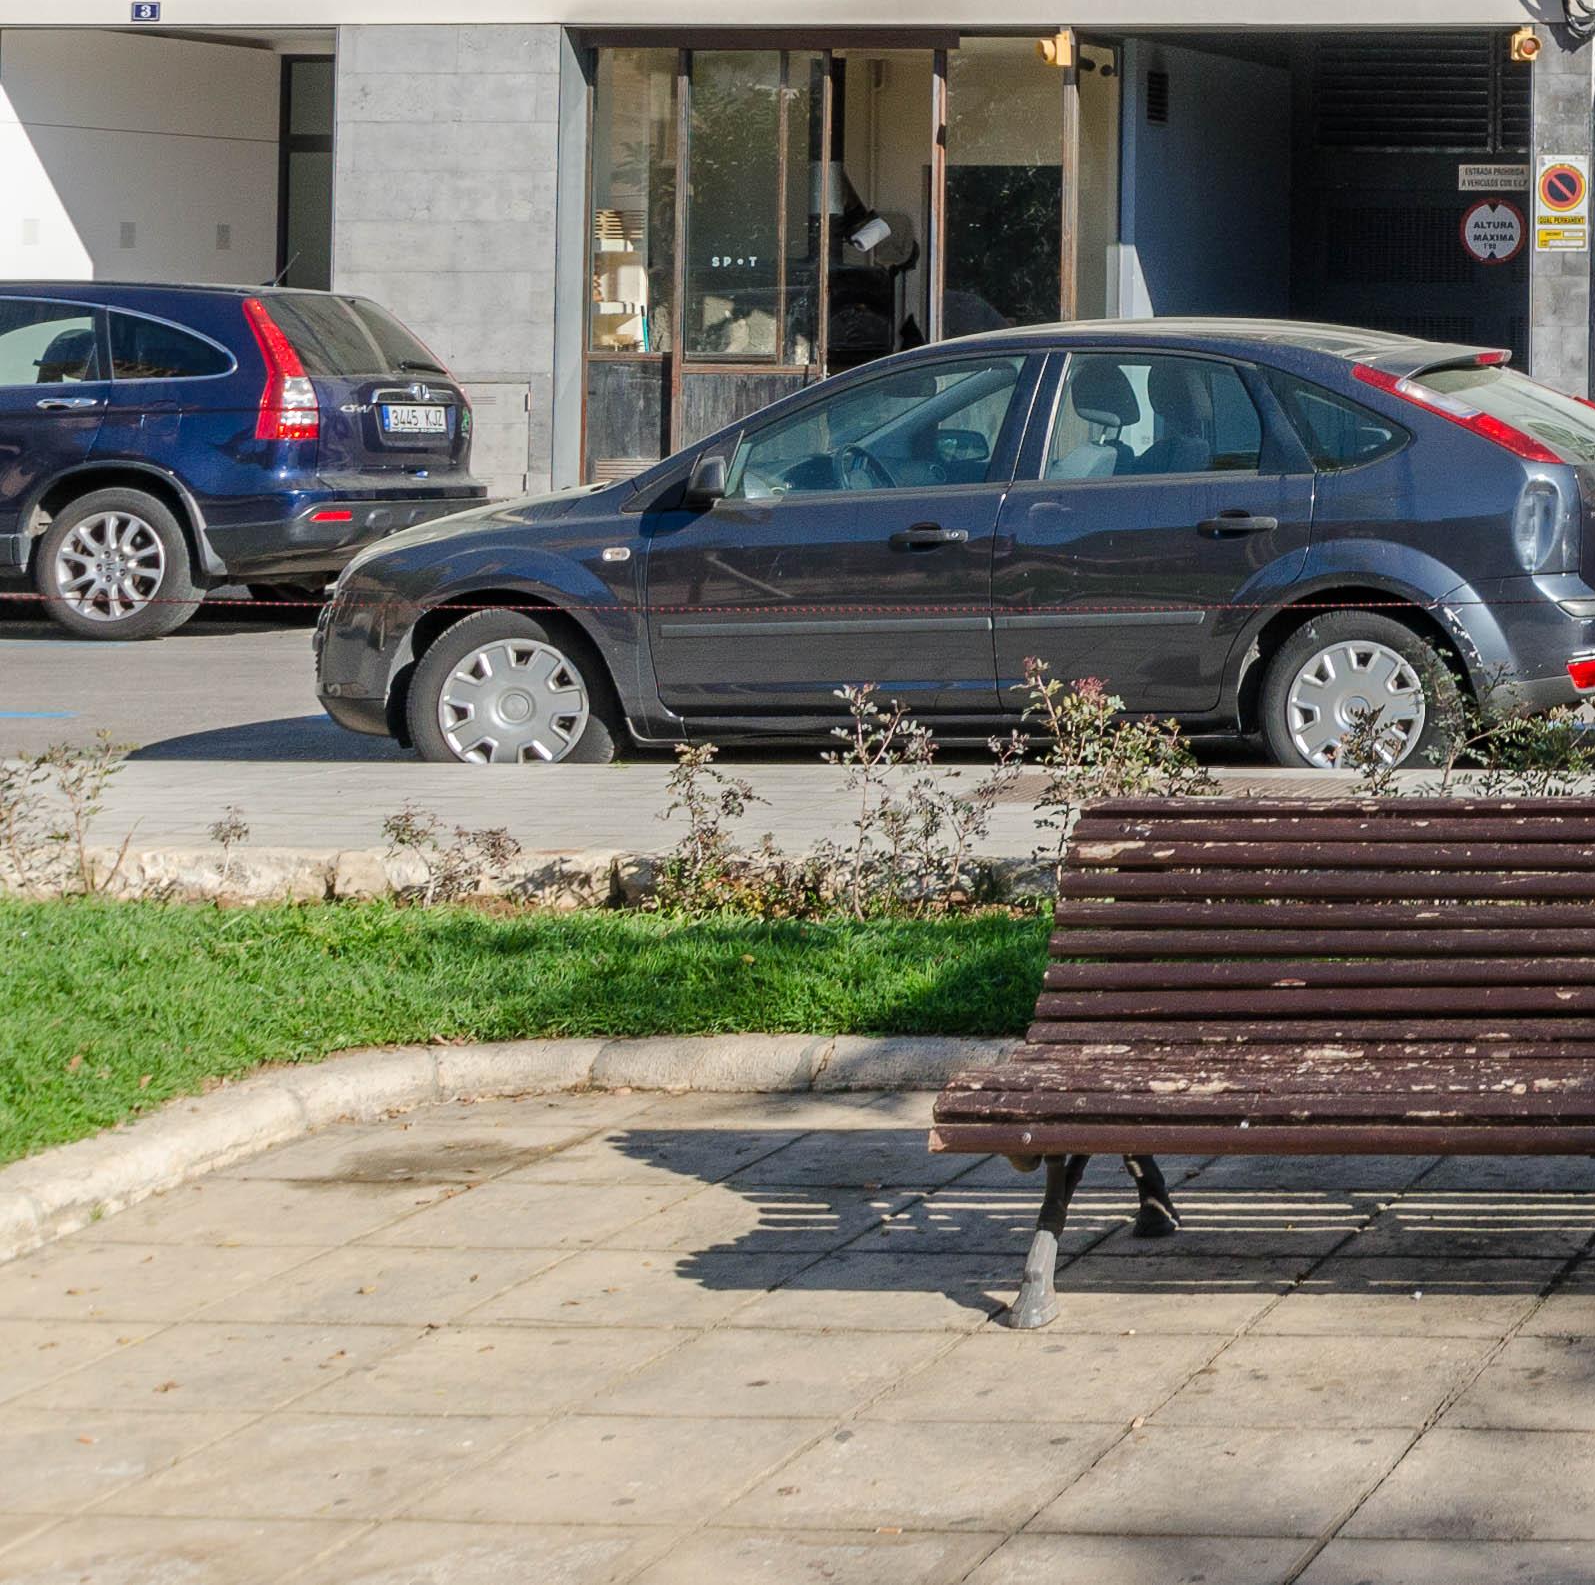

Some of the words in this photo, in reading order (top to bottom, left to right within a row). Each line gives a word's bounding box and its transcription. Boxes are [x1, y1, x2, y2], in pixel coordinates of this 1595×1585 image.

[140, 5, 152, 18] 3
[1473, 221, 1514, 230] ALTURA
[392, 410, 419, 427] 3445
[424, 410, 443, 427] KJZ
